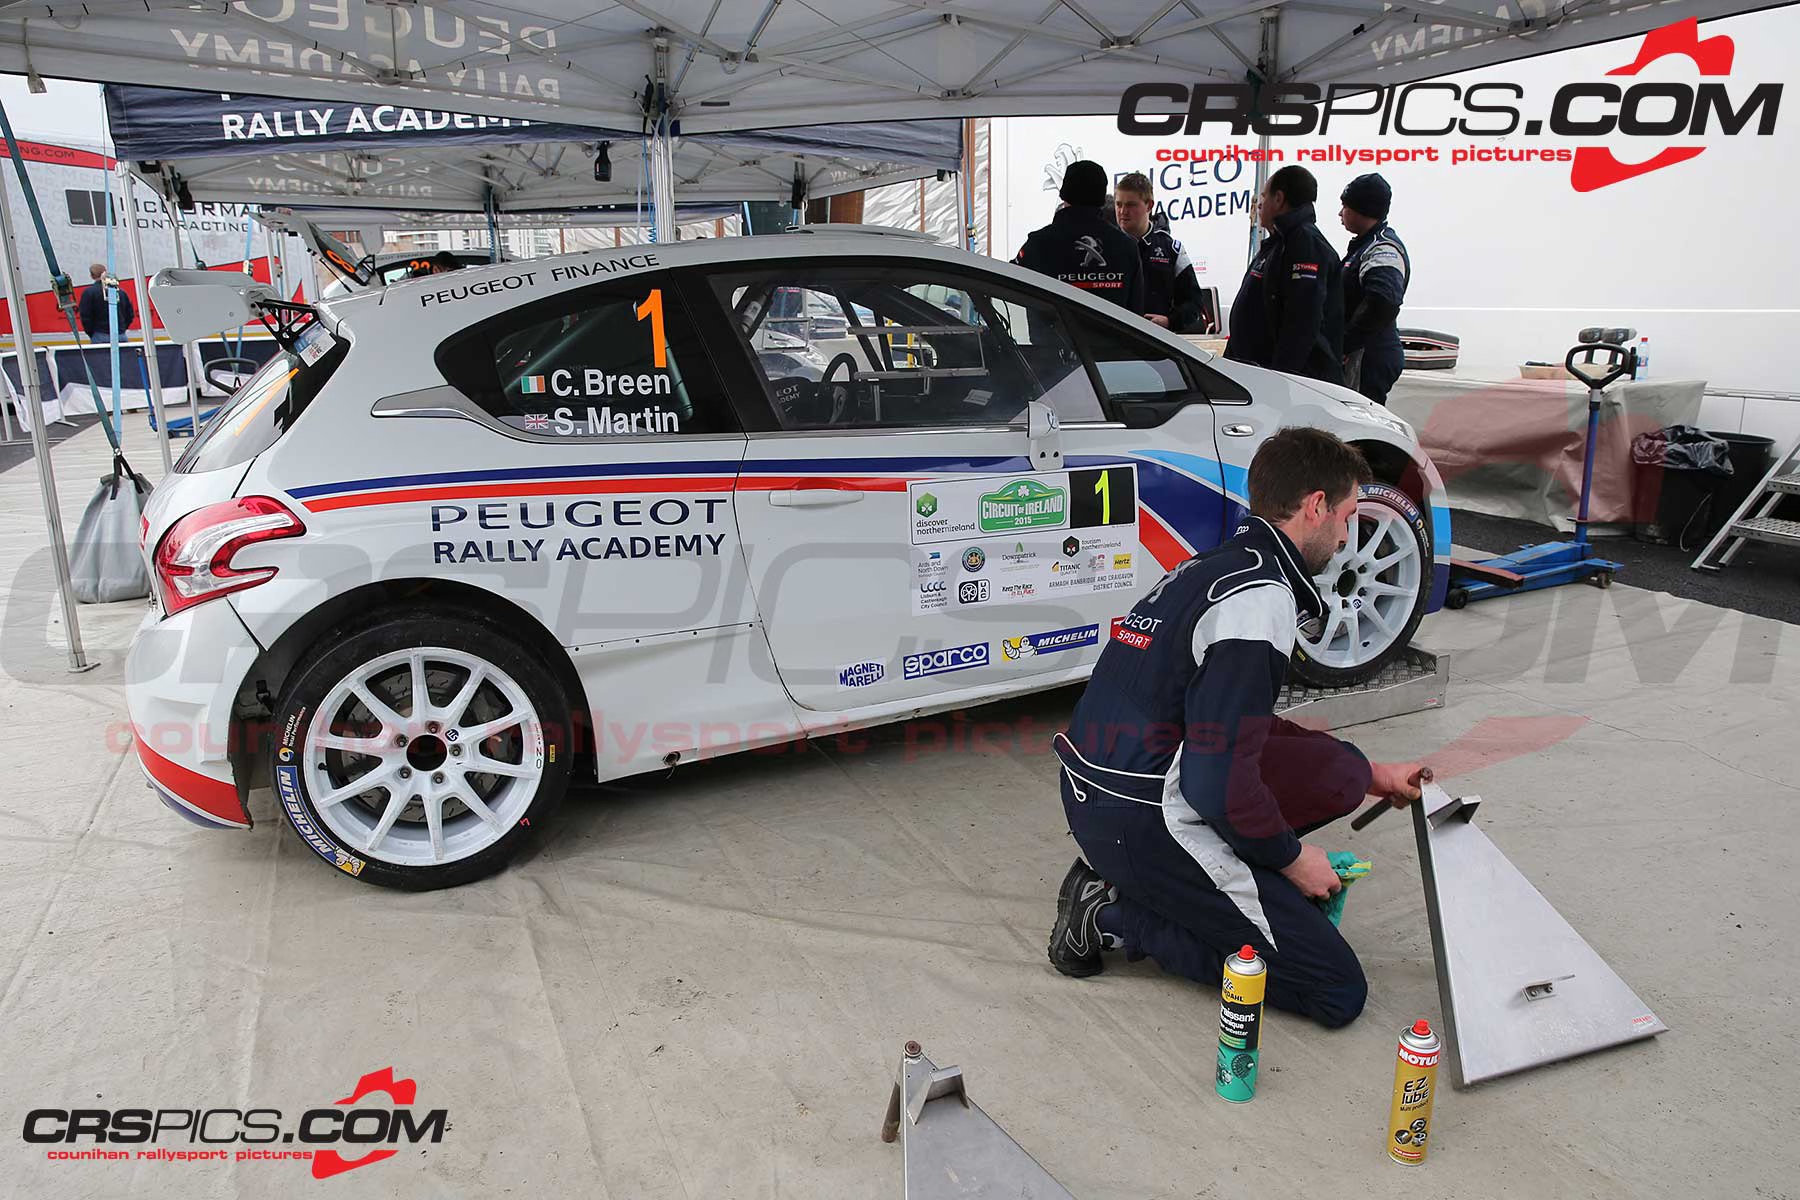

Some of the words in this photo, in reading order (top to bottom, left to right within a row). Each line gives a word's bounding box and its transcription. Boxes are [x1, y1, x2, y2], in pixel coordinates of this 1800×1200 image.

[222, 109, 333, 140] RALLY
[420, 273, 537, 307] PEUGEOT
[552, 254, 660, 282] FINANCE
[1057, 272, 1125, 281] PEUGEOT
[637, 289, 667, 368] 1
[584, 368, 671, 396] Breen
[588, 405, 680, 434] Martin
[982, 501, 1018, 519] CIRCUIT
[1025, 494, 1063, 515] IRELAND
[1095, 470, 1111, 525] 1
[1368, 486, 1417, 516] MICHELIN
[432, 499, 727, 532] PEUGEOT
[916, 519, 948, 528] discover
[1014, 516, 1032, 526] 2015
[434, 538, 545, 564] RALLY
[556, 533, 727, 561] ACADEMY
[1060, 563, 1081, 572] TITANIC
[1114, 558, 1130, 566] Hertz
[1038, 629, 1099, 647] MICHELIN
[1117, 630, 1150, 648] SPORT
[905, 646, 987, 672] sparco
[279, 769, 332, 854] MICHELIN
[1399, 1048, 1439, 1066] MOTUL
[1402, 1088, 1430, 1105] lube
